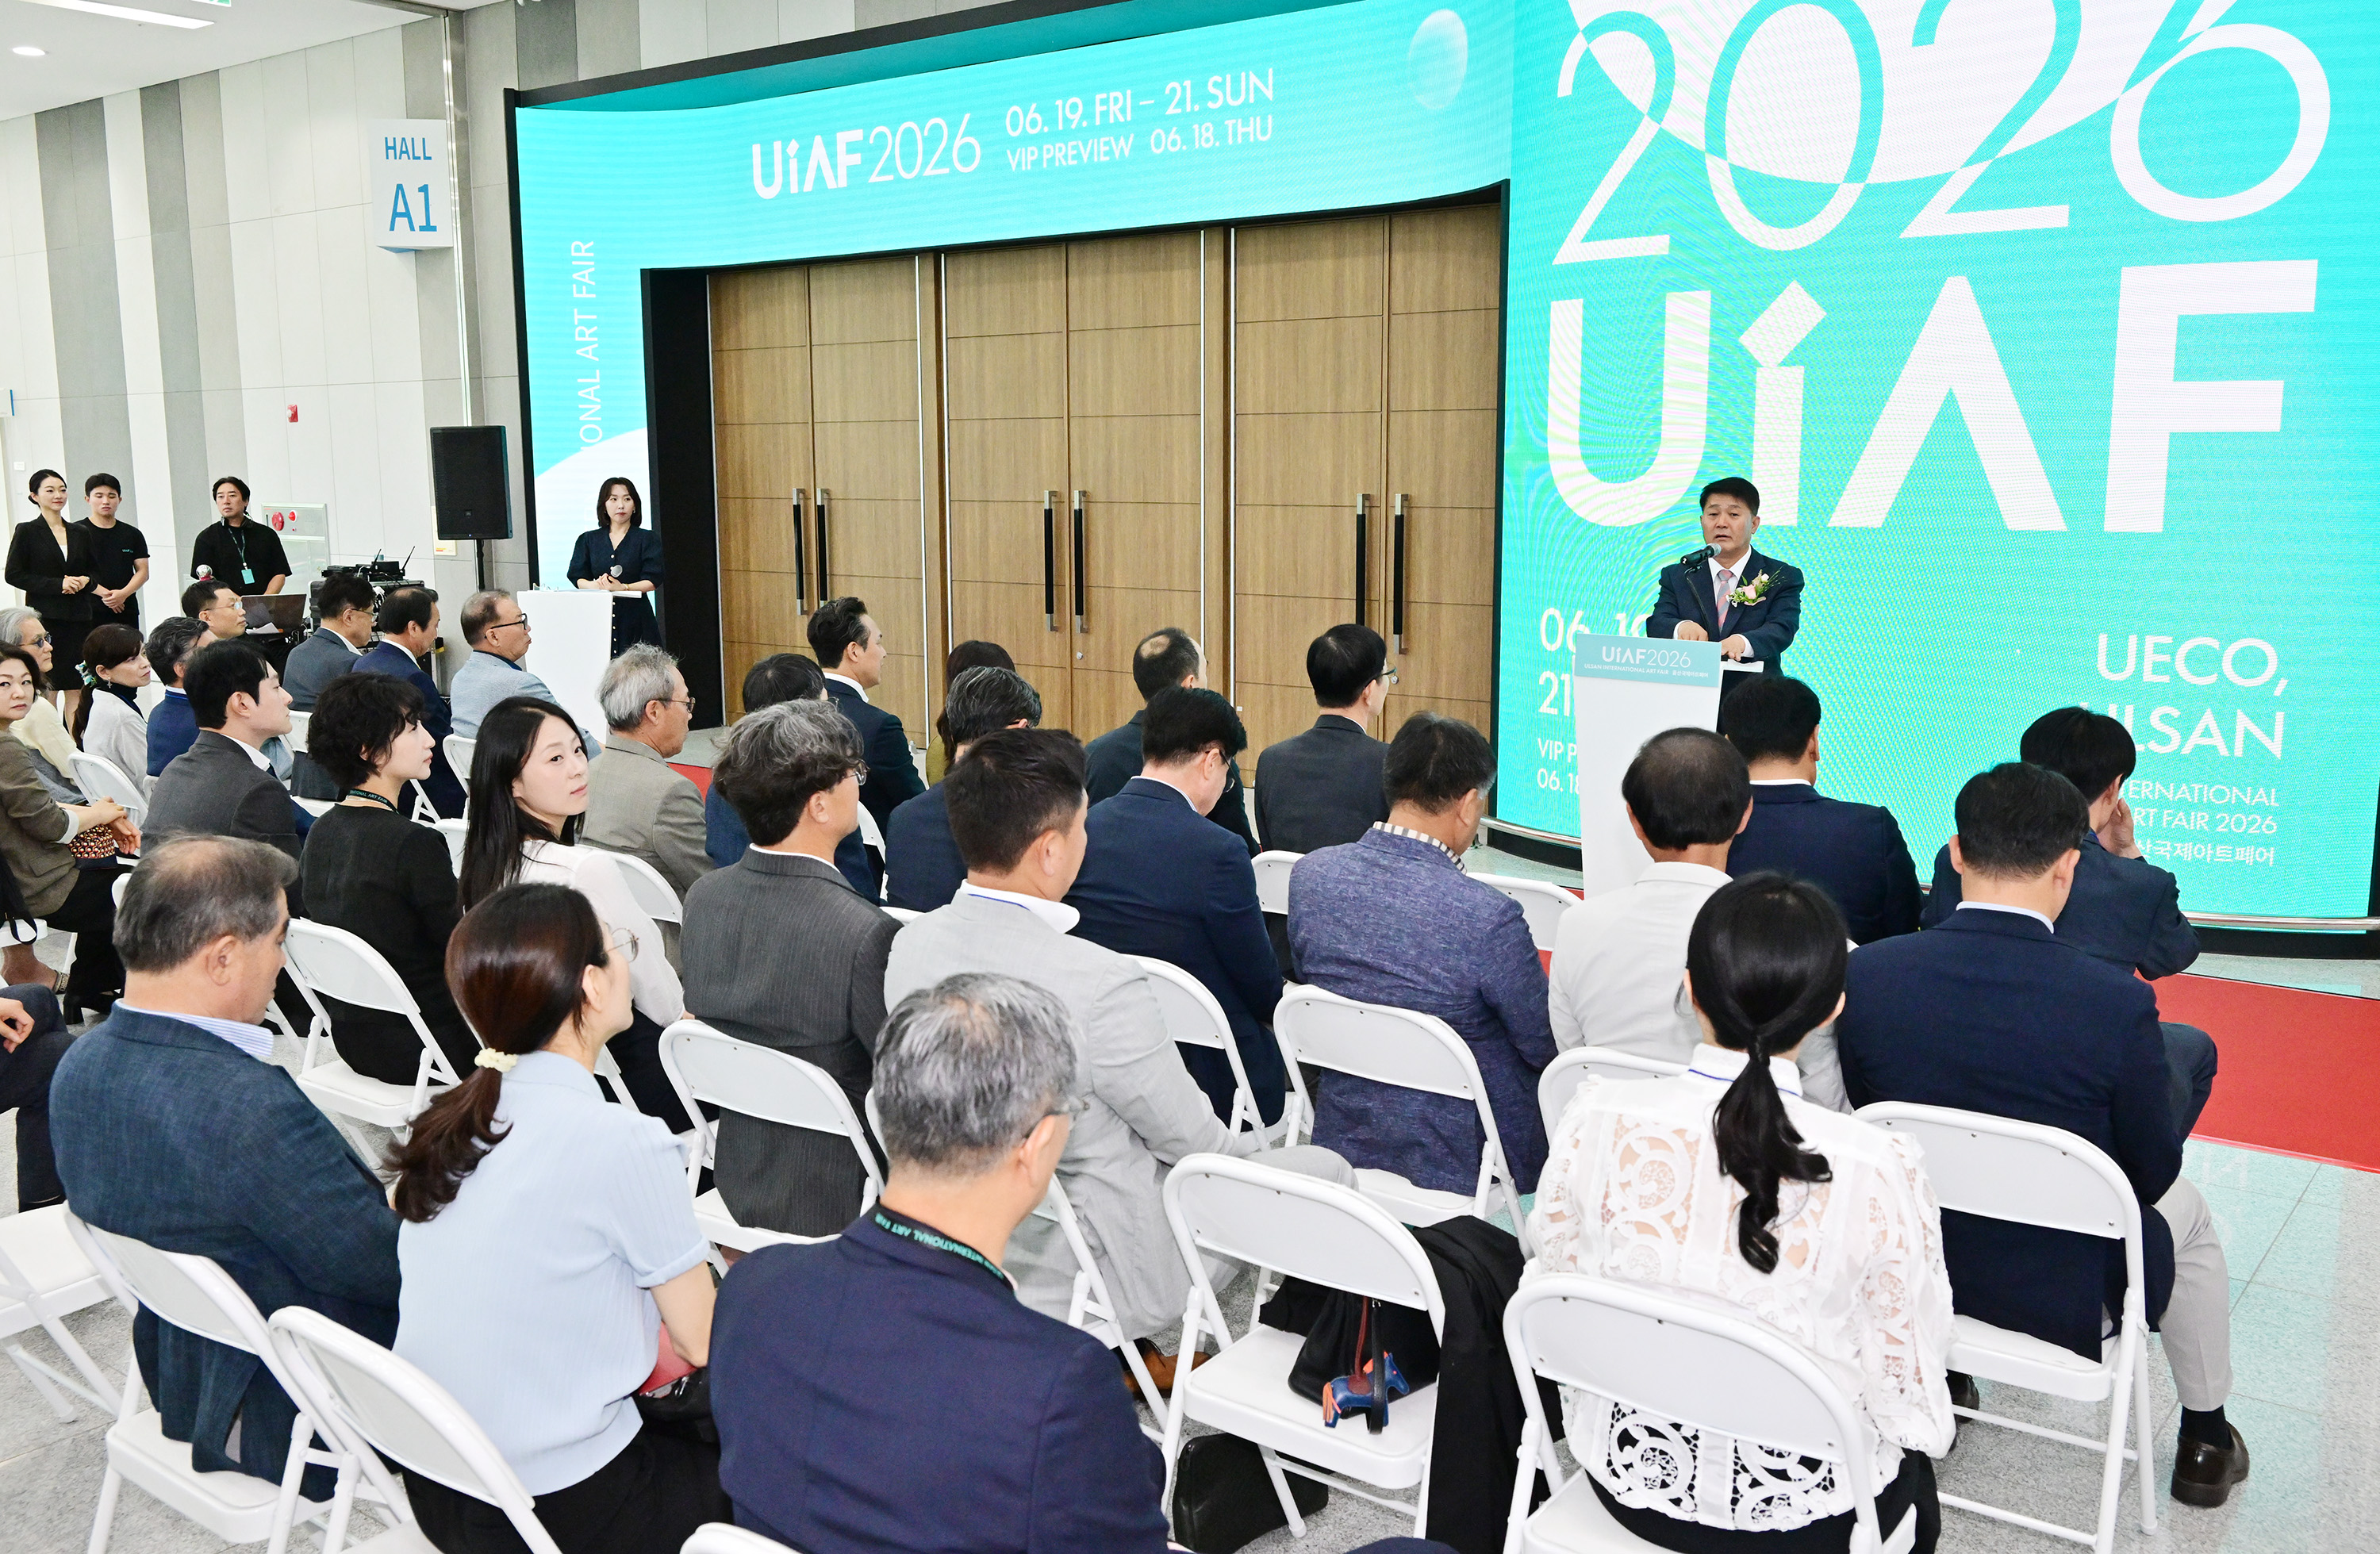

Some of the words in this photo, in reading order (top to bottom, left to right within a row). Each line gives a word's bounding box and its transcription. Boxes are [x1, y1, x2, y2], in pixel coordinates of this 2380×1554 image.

[1005, 102, 1049, 137] 06.
[1054, 97, 1088, 131] 19.
[1095, 89, 1131, 125] FRI
[1164, 79, 1200, 115] 21.
[1207, 67, 1273, 109] SUN
[385, 136, 432, 160] HALL
[1006, 145, 1038, 172] VIP
[1042, 132, 1134, 169] PREVIEW
[1150, 126, 1187, 155] 06.
[1192, 121, 1220, 149] 18.
[1224, 114, 1273, 146] THU
[1551, 0, 2331, 265] 2026
[389, 183, 437, 232] A1
[570, 240, 597, 298] FAIR
[574, 308, 600, 362] ART
[2096, 633, 2290, 697] UECO,
[1537, 738, 1564, 761] VIP
[2079, 702, 2285, 760] LSAN
[1537, 768, 1564, 792] 06.
[2128, 780, 2280, 807] ERNATIONAL
[2134, 807, 2158, 827] RT
[2162, 809, 2209, 831] FAIR
[2215, 813, 2278, 835] 2026
[2136, 838, 2275, 867] 산국제아트페어
